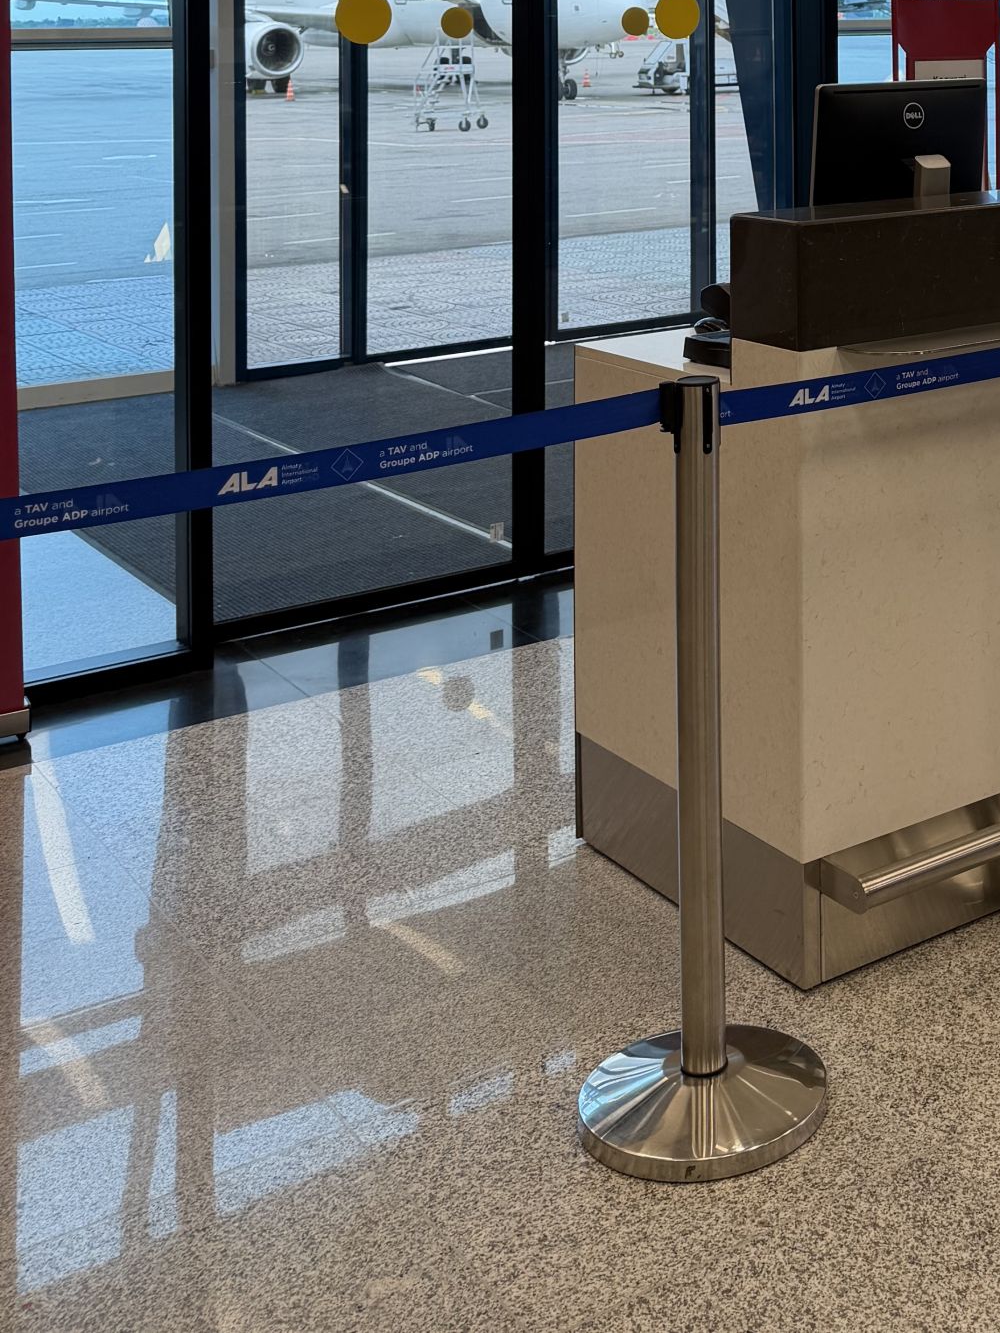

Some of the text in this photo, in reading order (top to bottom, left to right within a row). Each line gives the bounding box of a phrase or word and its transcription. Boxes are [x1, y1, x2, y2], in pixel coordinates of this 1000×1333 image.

[905, 111, 923, 119] DELL
[896, 372, 960, 390] Groupe ADP airport
[902, 370, 915, 379] TAV
[788, 384, 830, 407] ALA
[379, 444, 473, 470] Groupe ADP airport
[387, 444, 408, 456] TAV
[409, 440, 428, 451] and
[217, 466, 278, 495] ALA
[14, 498, 74, 516] a TAV and
[14, 503, 129, 529] Groupe ADP airport
